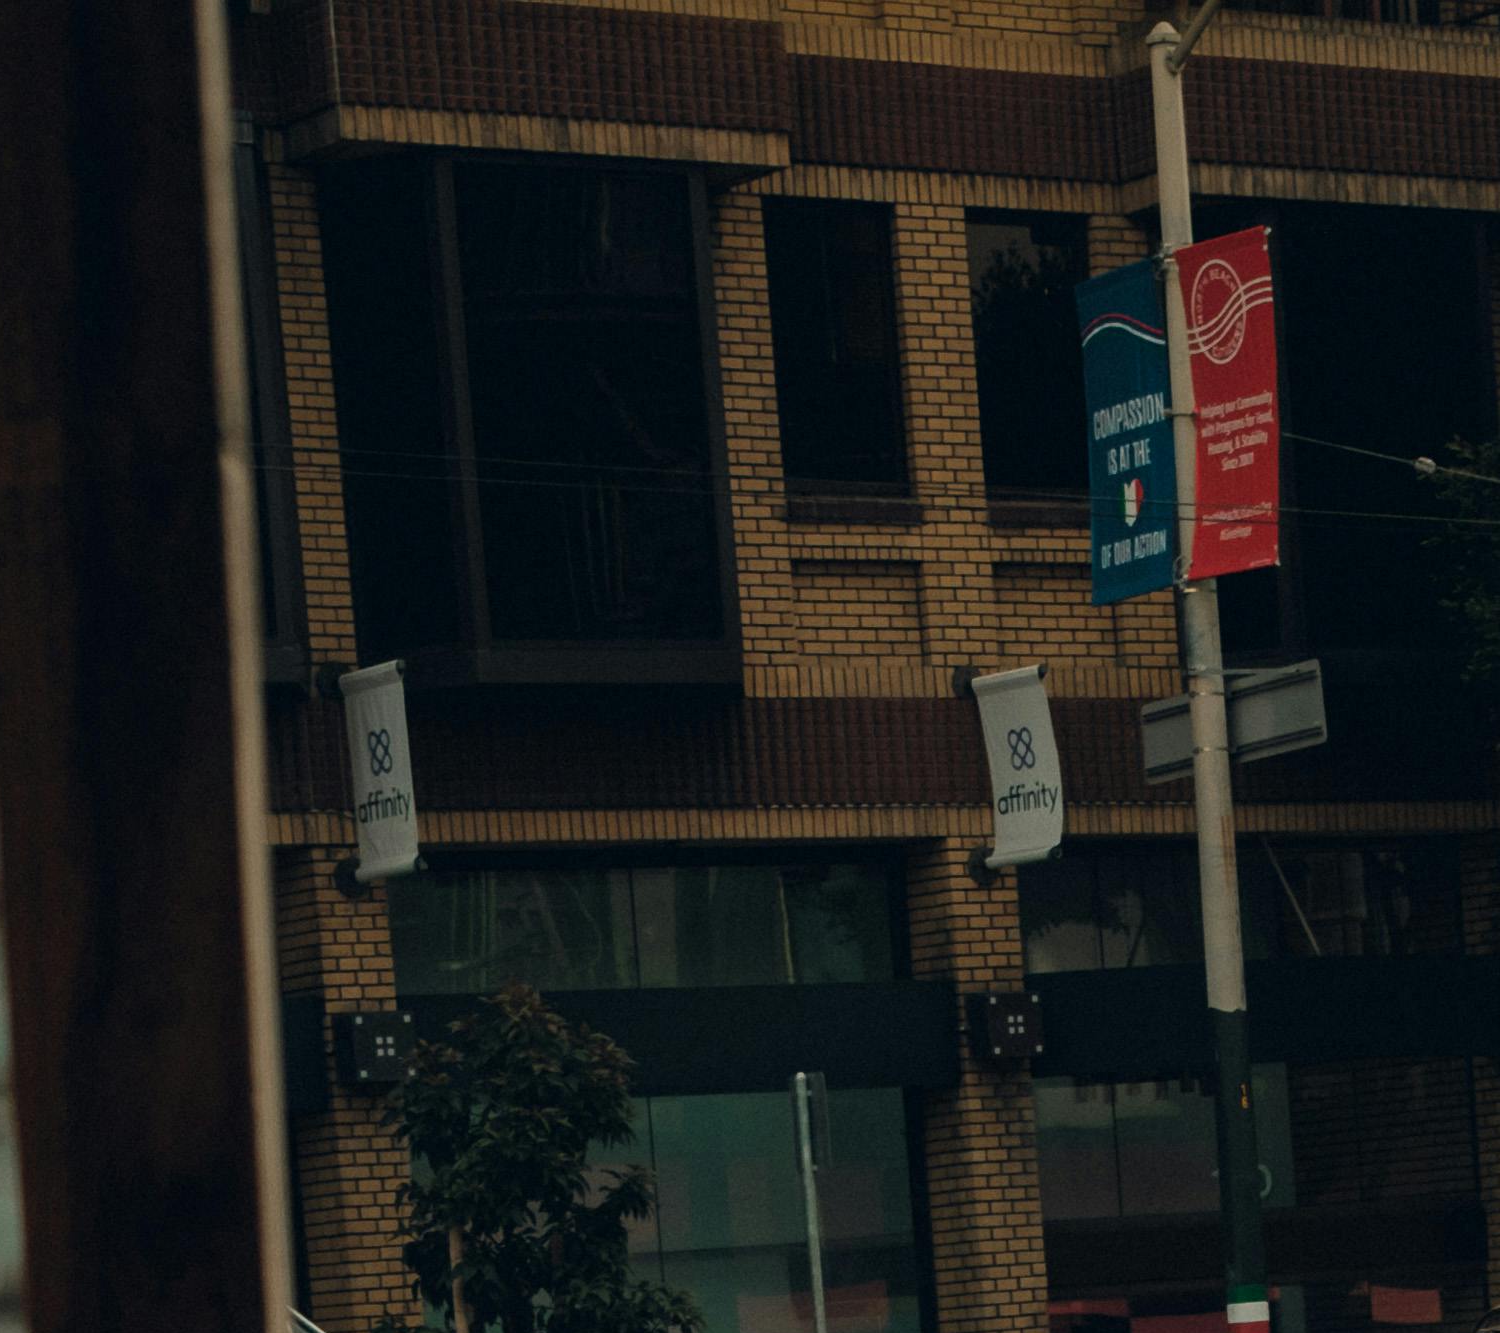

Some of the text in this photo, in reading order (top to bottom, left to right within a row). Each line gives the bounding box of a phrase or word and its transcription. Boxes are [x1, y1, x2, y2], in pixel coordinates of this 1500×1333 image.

[1092, 392, 1166, 441] COMPASSION
[1107, 438, 1153, 476] IS AT THE
[1101, 529, 1168, 569] OF OUR ACTION
[359, 787, 411, 824] affinity
[998, 781, 1058, 815] affinity
